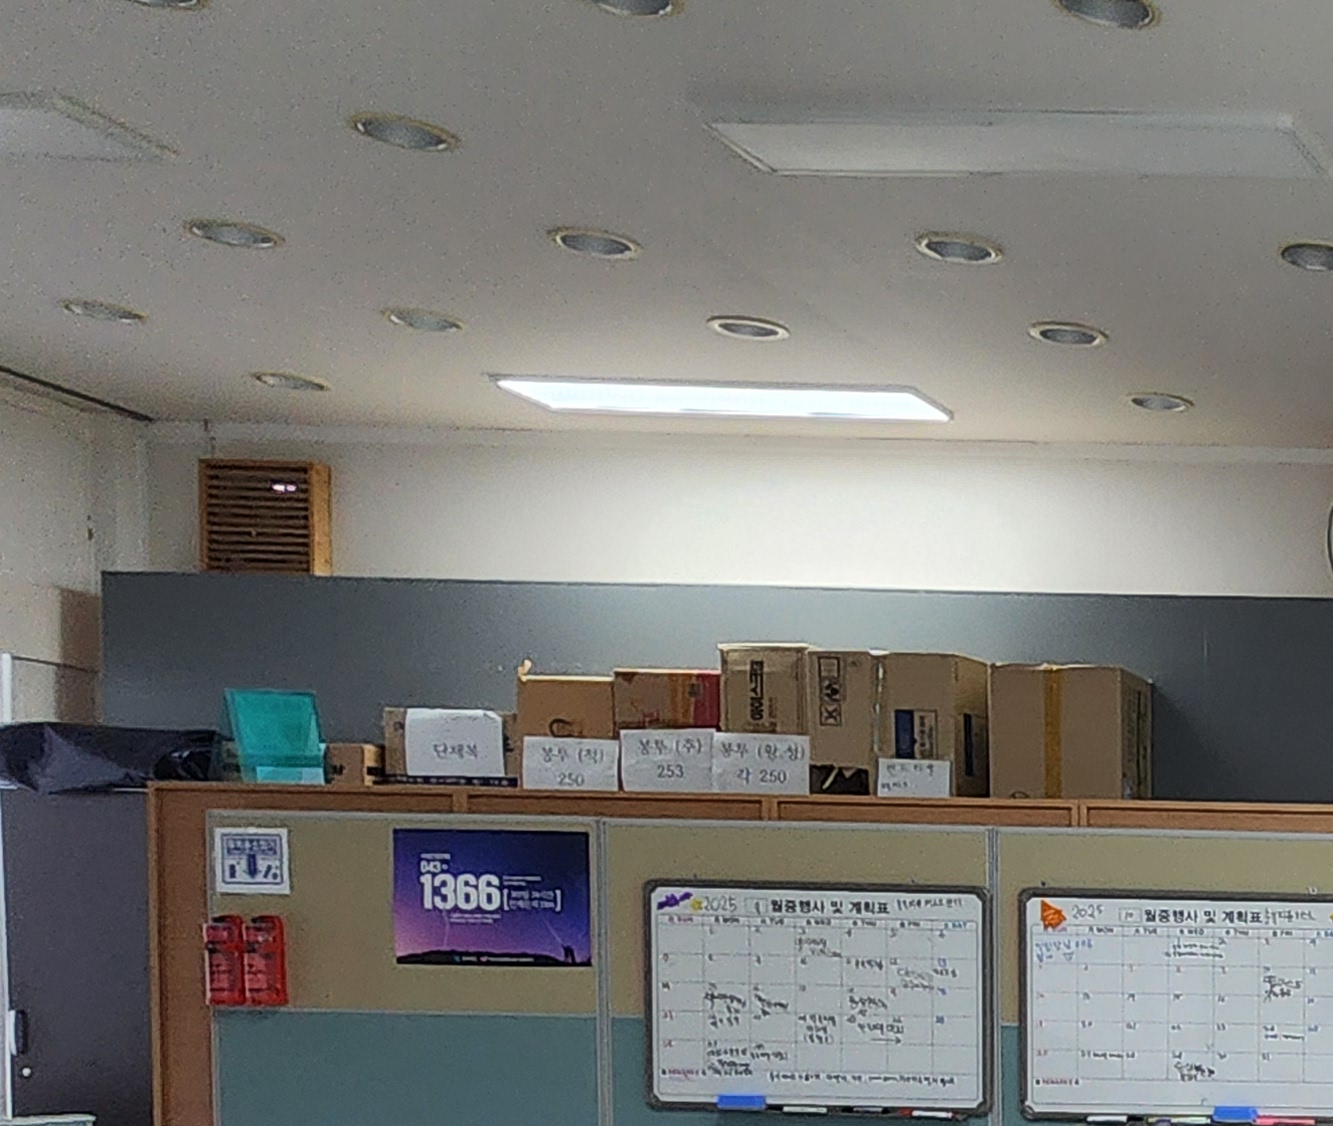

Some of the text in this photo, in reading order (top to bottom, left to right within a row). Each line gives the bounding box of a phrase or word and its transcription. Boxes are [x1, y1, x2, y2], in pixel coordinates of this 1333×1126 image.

[657, 763, 684, 779] 253
[760, 768, 788, 785] 250
[558, 772, 585, 787] 250
[419, 873, 500, 911] 1366
[704, 896, 737, 912] 2025
[1071, 904, 1104, 919] 2025
[1123, 911, 1135, 920] 10
[1203, 910, 1217, 924] 및
[1222, 910, 1264, 925] 계획표
